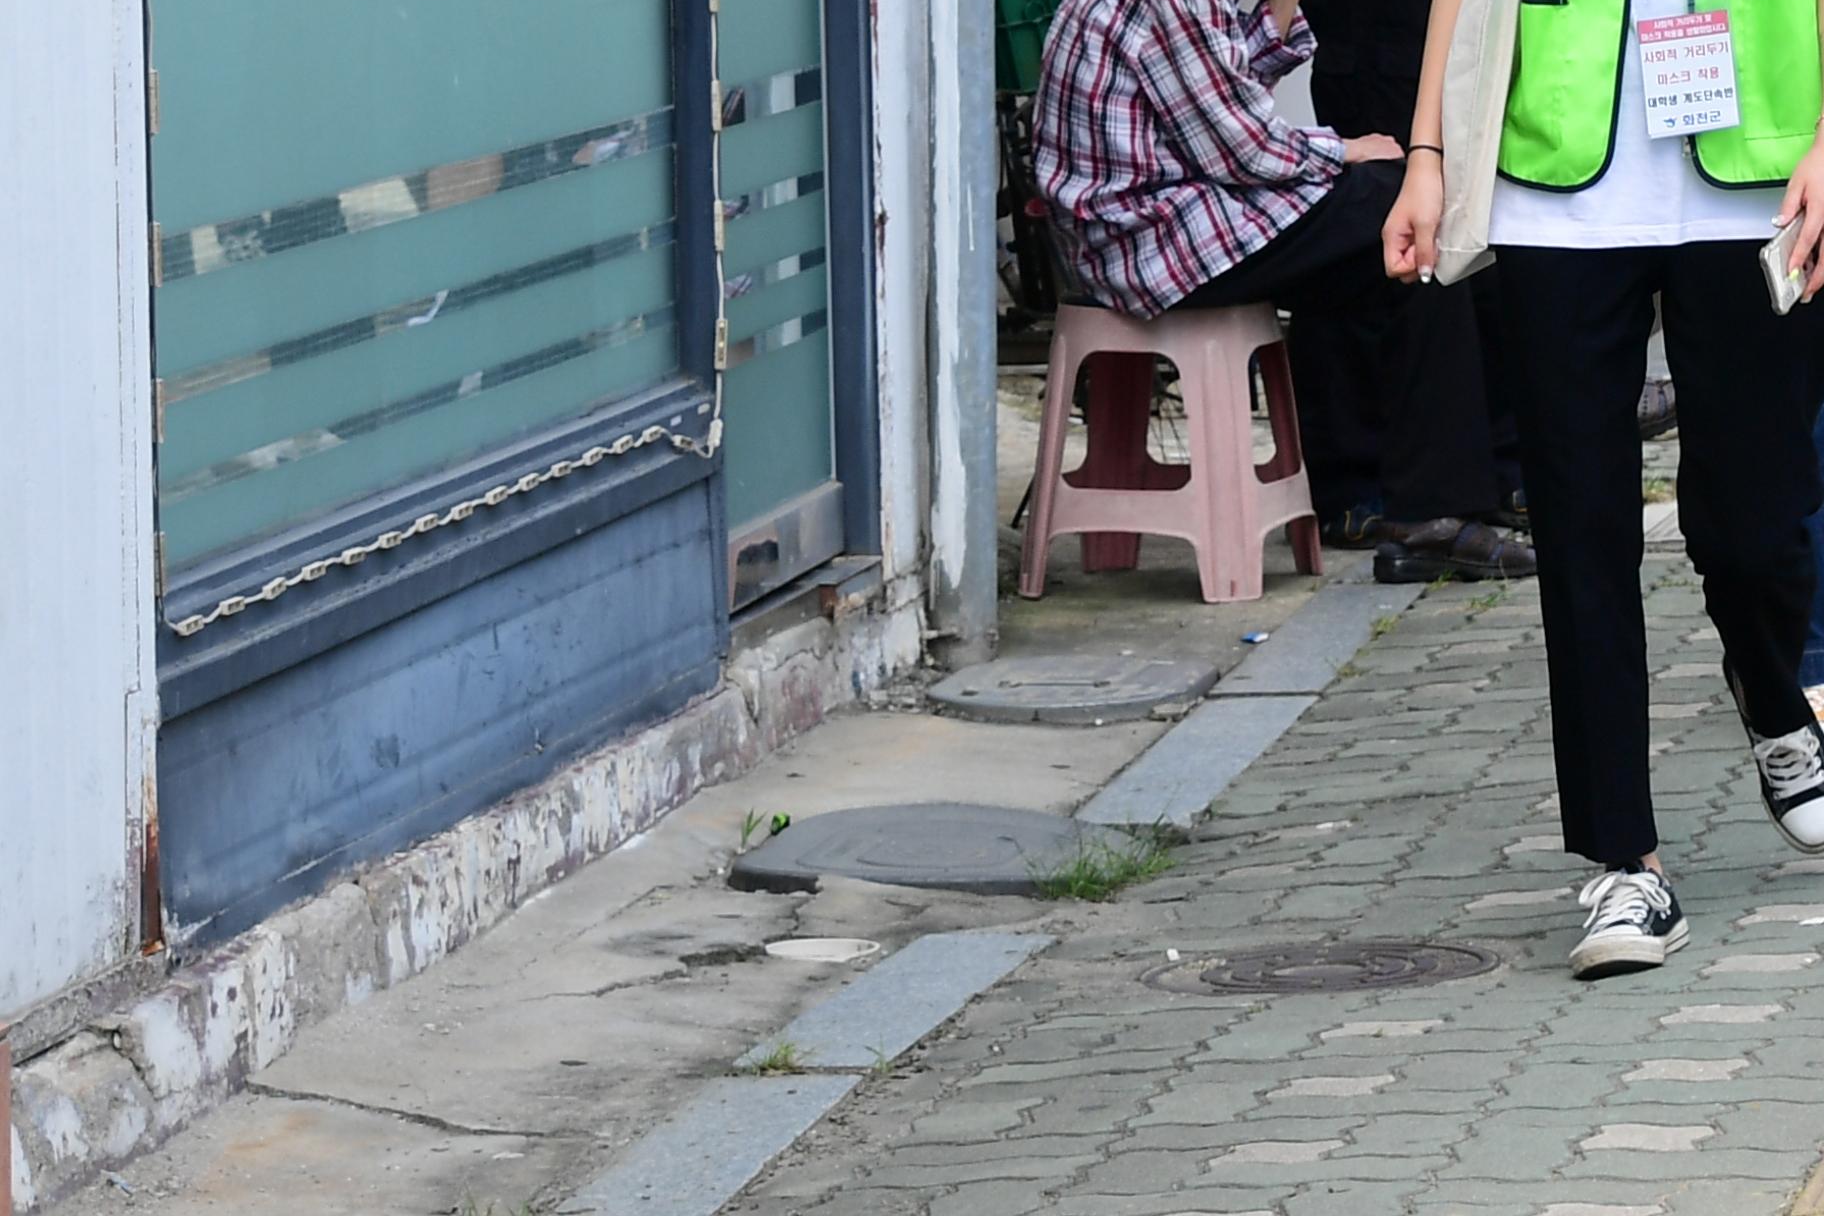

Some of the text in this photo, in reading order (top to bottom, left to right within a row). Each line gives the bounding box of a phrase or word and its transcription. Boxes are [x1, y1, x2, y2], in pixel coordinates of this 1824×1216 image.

[1644, 41, 1729, 64] 사회적 거리두기
[1657, 70, 1692, 86] 마스크
